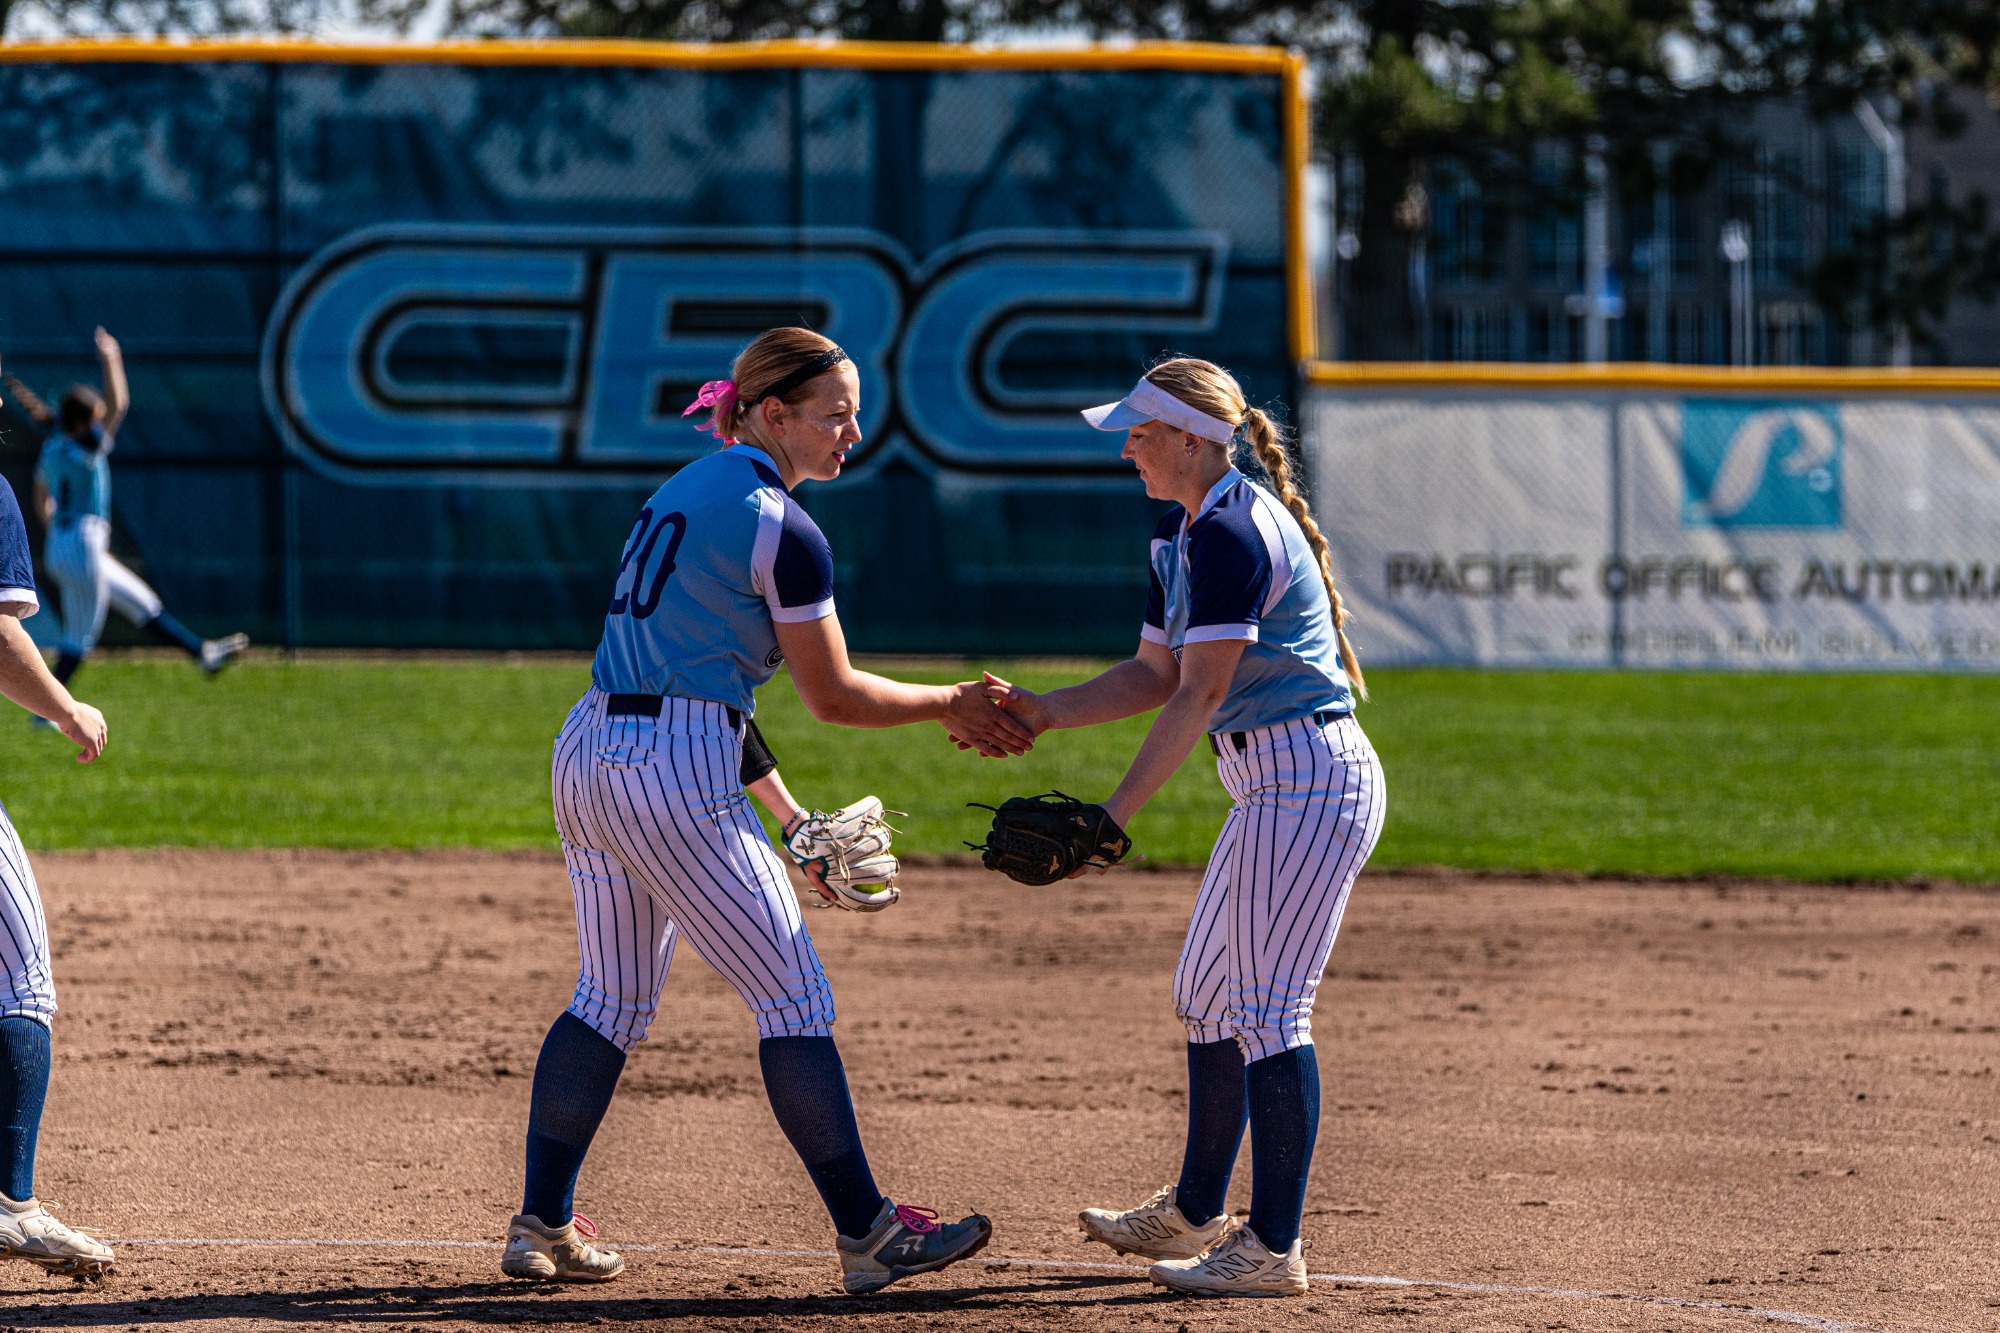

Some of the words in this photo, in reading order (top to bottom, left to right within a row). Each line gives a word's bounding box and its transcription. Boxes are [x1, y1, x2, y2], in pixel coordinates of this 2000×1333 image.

[260, 224, 1229, 489] CBC
[610, 507, 687, 619] 20
[1384, 552, 1581, 600] PACIFIC
[1597, 554, 1783, 605] OFFICE
